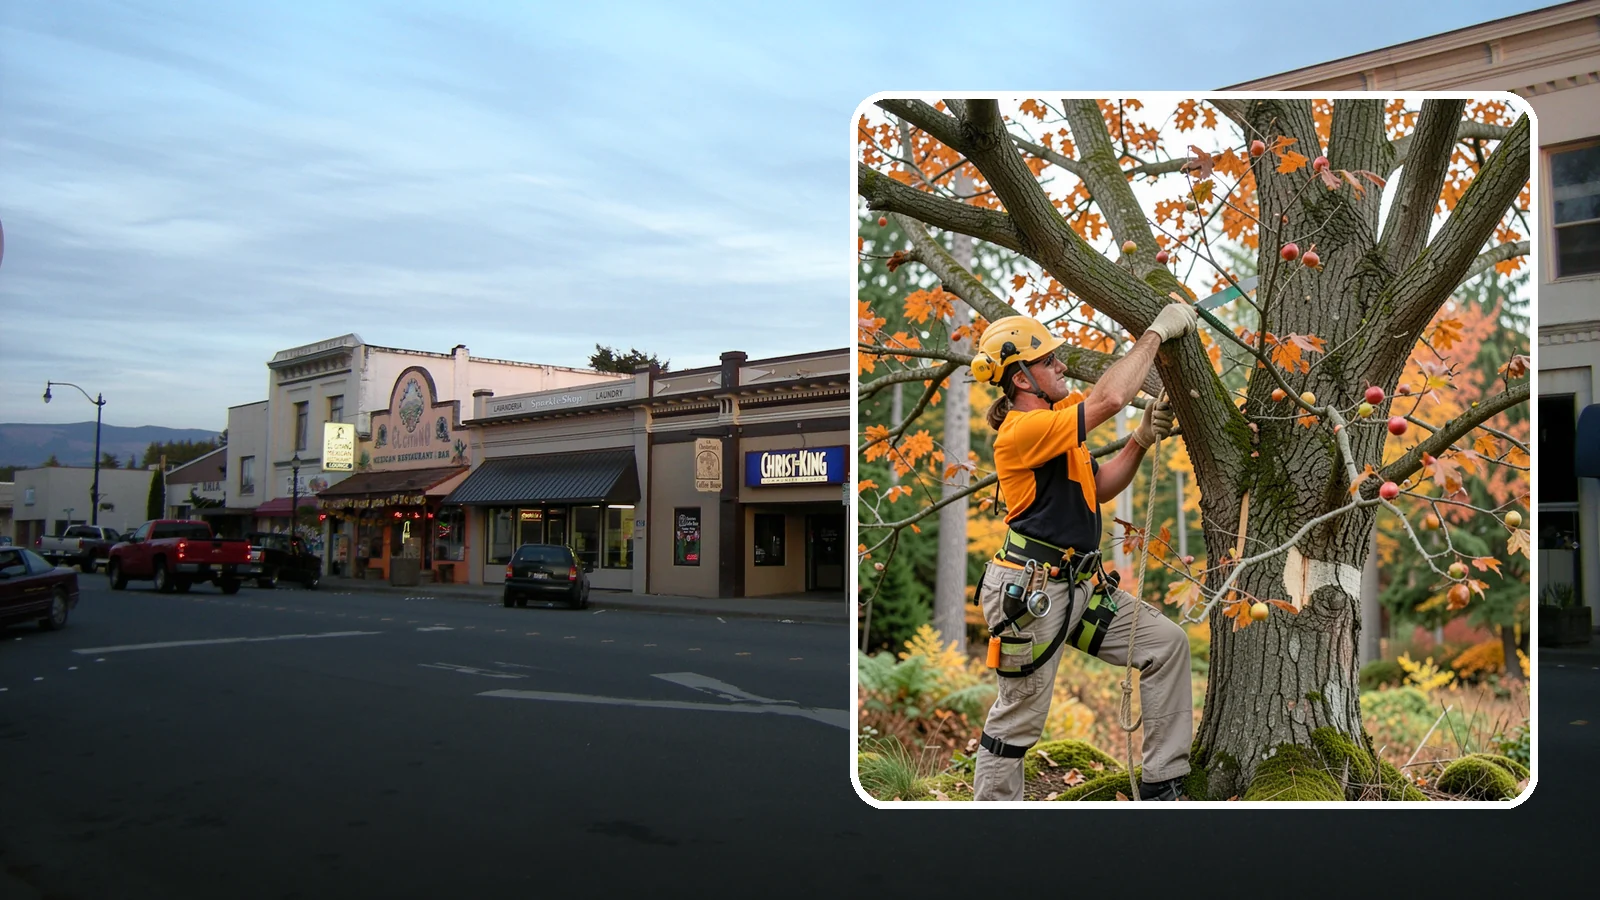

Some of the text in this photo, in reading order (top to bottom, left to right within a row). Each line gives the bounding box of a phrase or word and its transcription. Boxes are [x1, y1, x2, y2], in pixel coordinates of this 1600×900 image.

[595, 388, 624, 400] LAUNDRY
[493, 402, 523, 413] LAVANDERIA
[531, 394, 583, 409] Sparkle Shop
[391, 425, 402, 449] EL
[373, 454, 396, 464] MEXICAN
[397, 451, 433, 462] RESTAURANT
[437, 450, 450, 459] BAR
